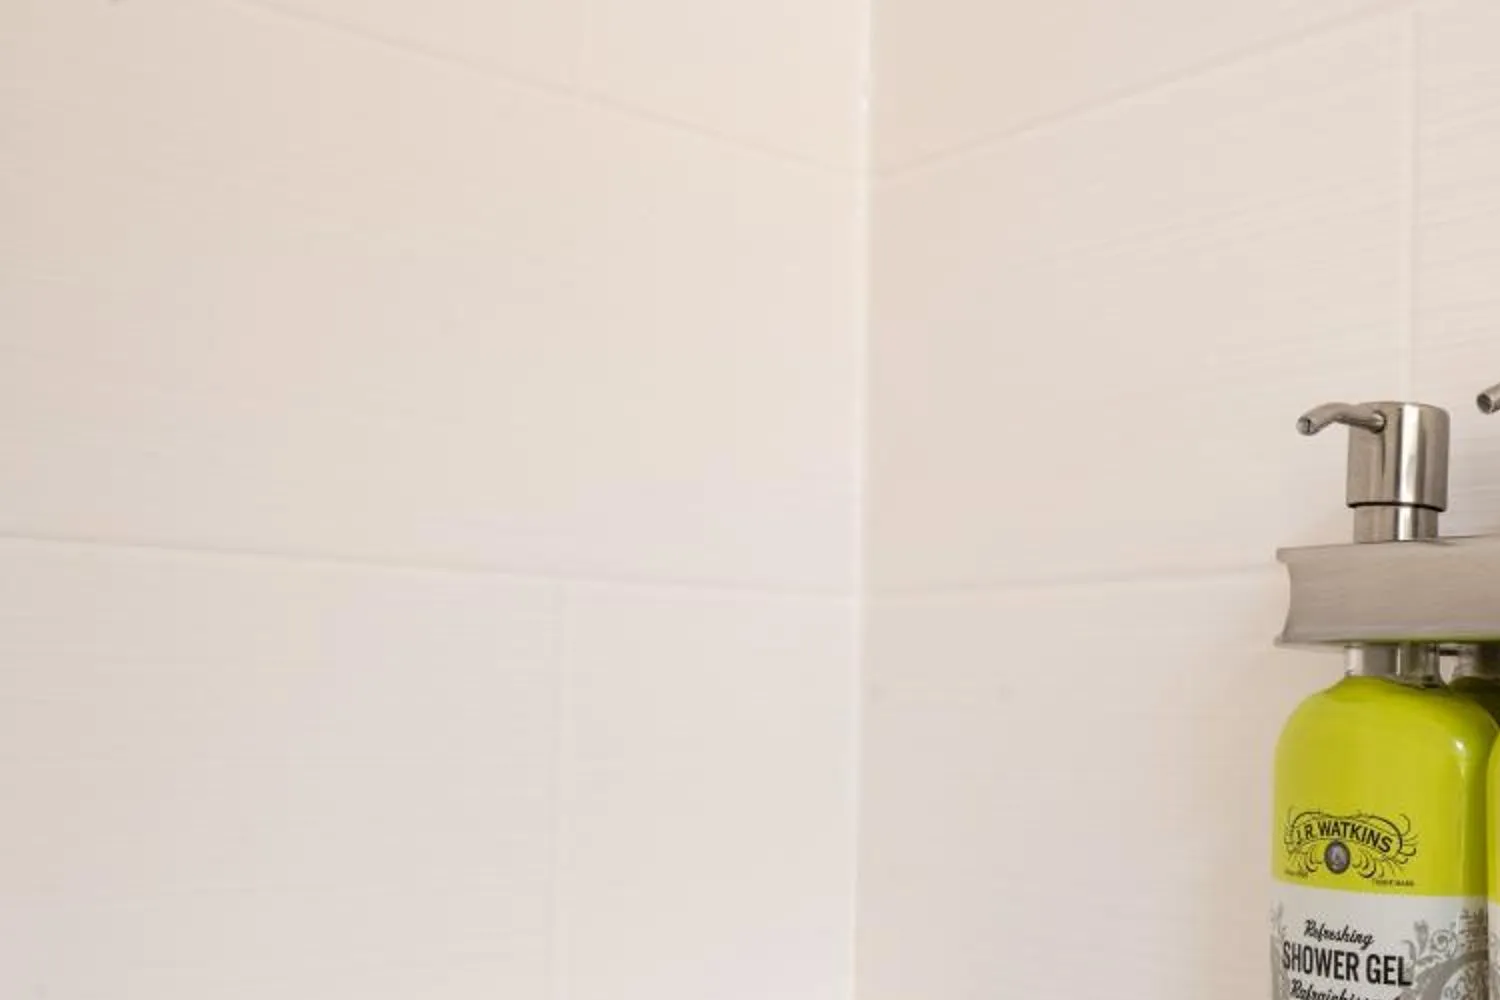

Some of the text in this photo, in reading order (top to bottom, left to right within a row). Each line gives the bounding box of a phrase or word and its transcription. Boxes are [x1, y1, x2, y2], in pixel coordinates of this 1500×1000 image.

[1318, 820, 1393, 853] WATKINS
[1304, 919, 1375, 950] Refreshing
[1282, 940, 1412, 987] SHOWER GEL
